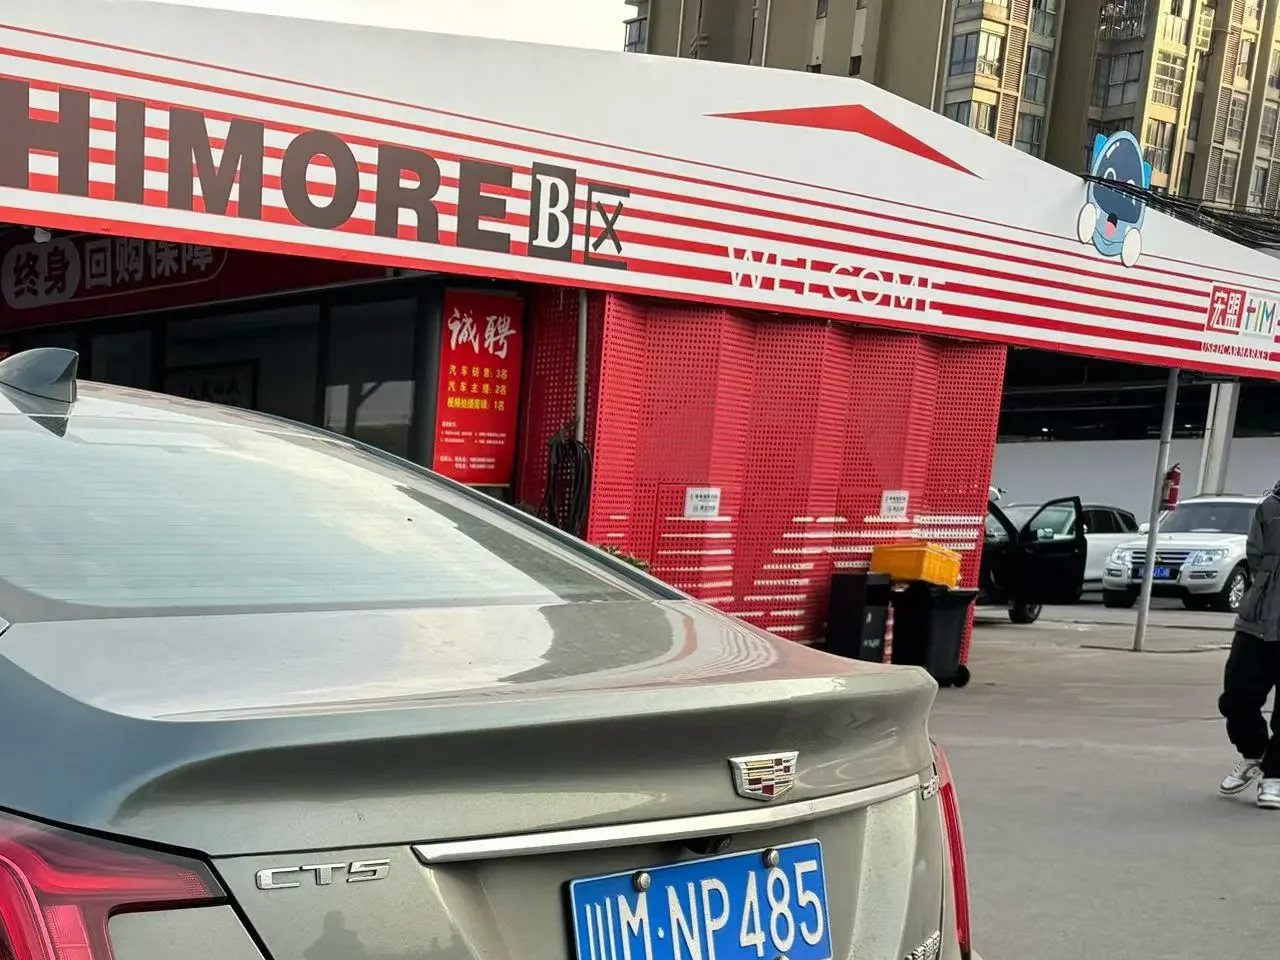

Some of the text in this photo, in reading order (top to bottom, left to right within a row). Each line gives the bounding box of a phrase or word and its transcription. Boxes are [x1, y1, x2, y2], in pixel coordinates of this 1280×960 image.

[728, 245, 946, 314] WELCOME
[1209, 290, 1242, 329] 宏盟
[255, 859, 391, 890] CT5
